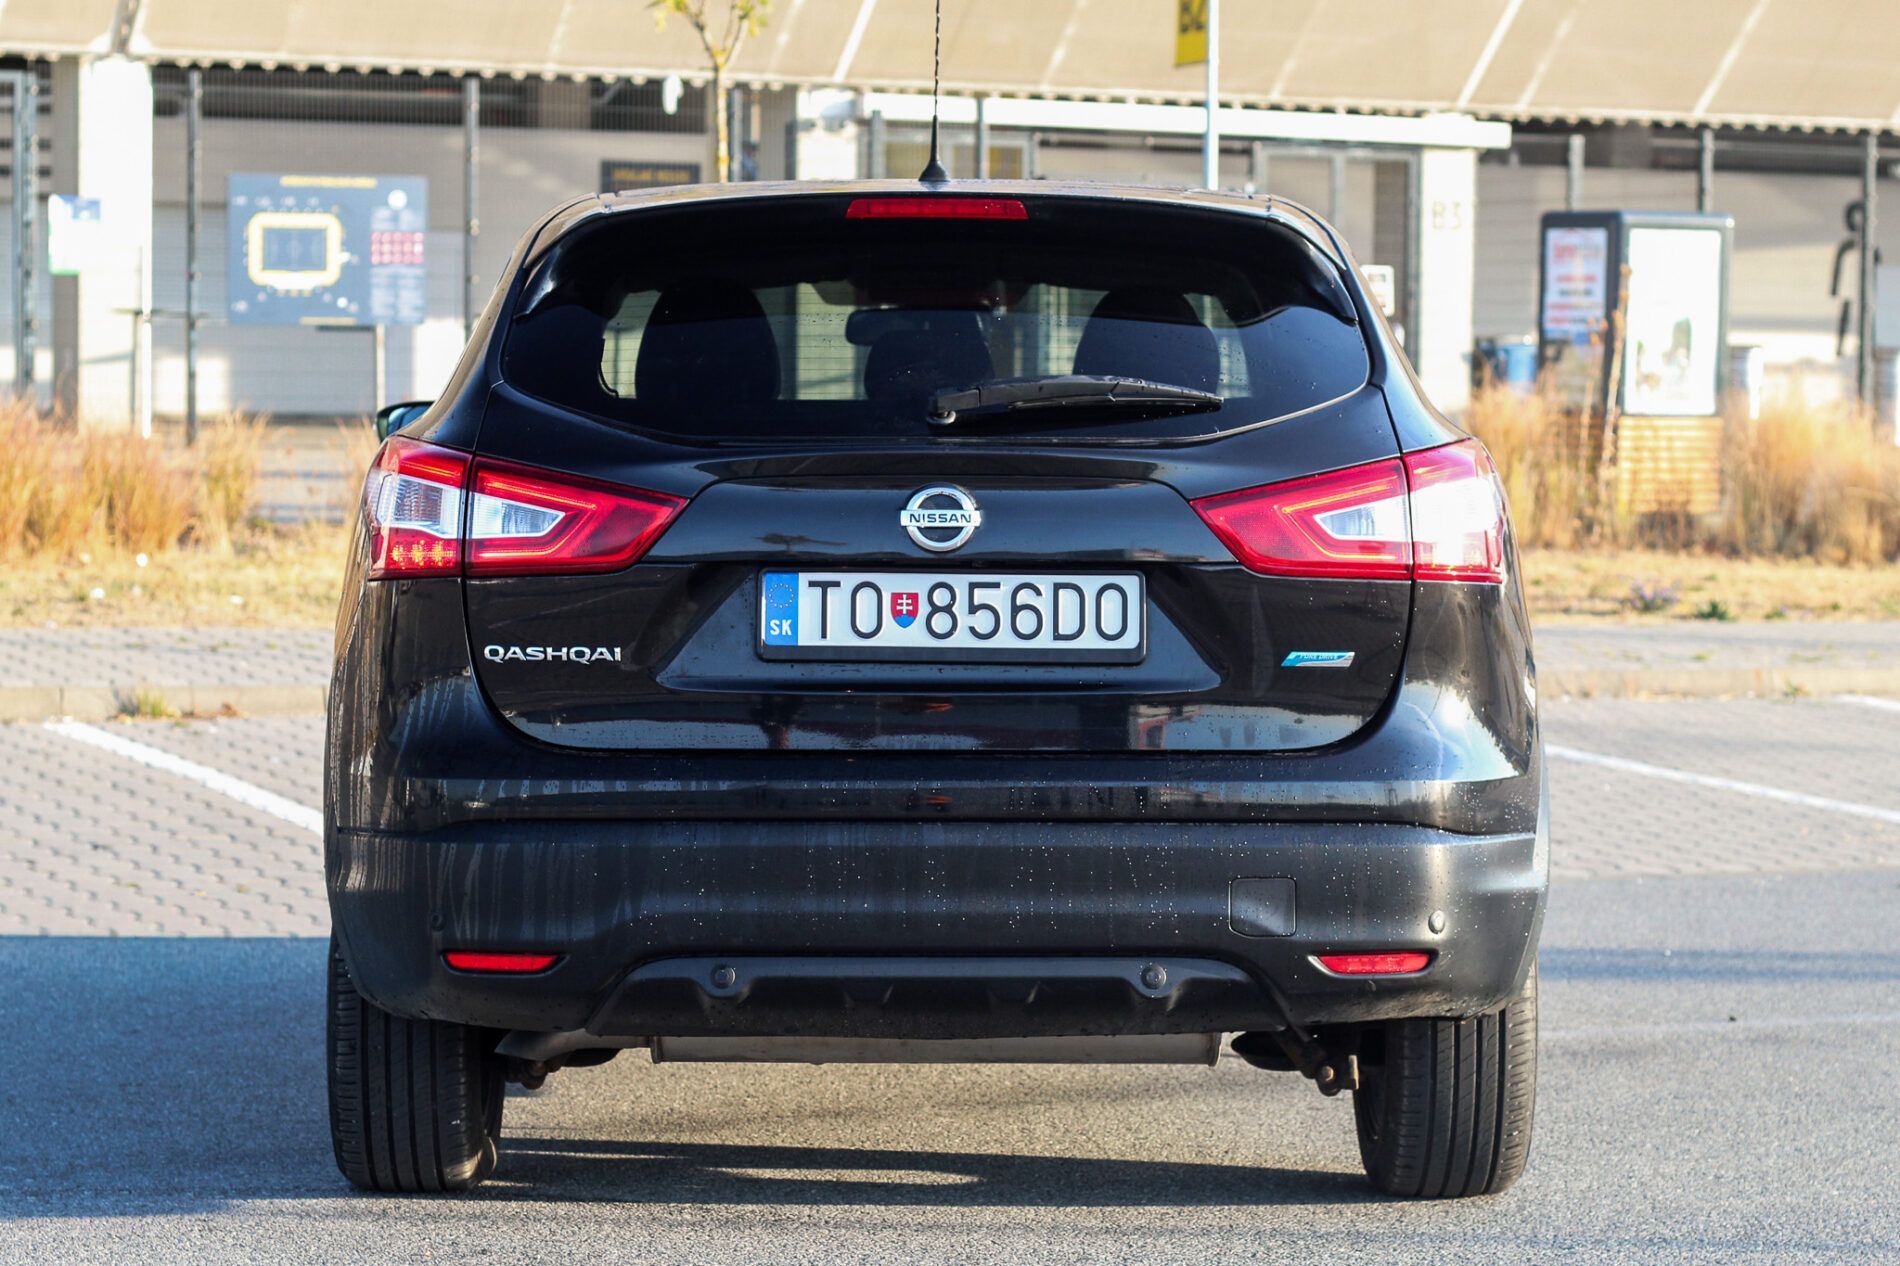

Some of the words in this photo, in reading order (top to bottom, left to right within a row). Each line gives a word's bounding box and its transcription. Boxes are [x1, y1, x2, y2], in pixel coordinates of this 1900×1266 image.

[908, 512, 973, 525] NISSAN
[769, 618, 793, 637] SK
[483, 645, 622, 664] QASHQAI
